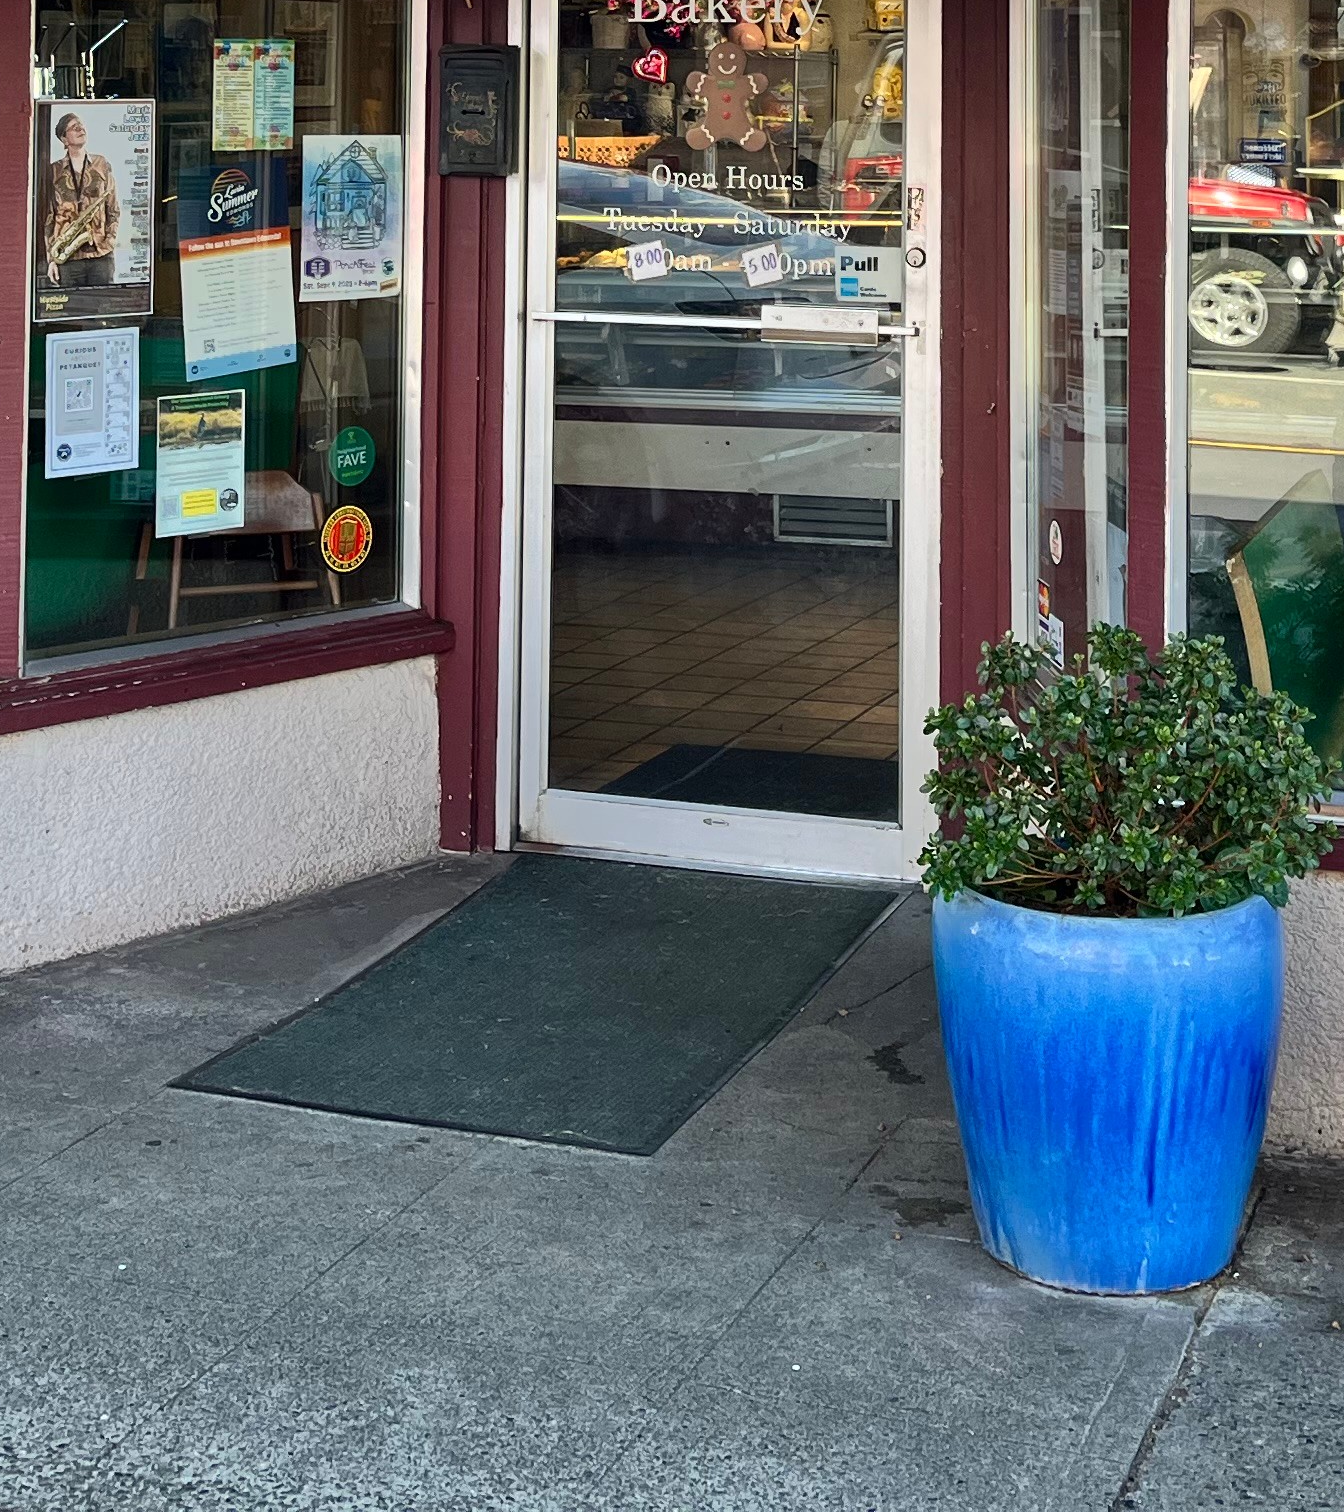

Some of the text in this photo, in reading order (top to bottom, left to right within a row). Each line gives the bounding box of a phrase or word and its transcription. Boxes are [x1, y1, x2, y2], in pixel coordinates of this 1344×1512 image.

[651, 164, 804, 195] Open Hours
[207, 188, 259, 222] Summer
[602, 207, 708, 237] Tuesday
[732, 212, 852, 242] Saturday
[840, 255, 879, 272] Pull
[337, 450, 367, 469] FAVE
